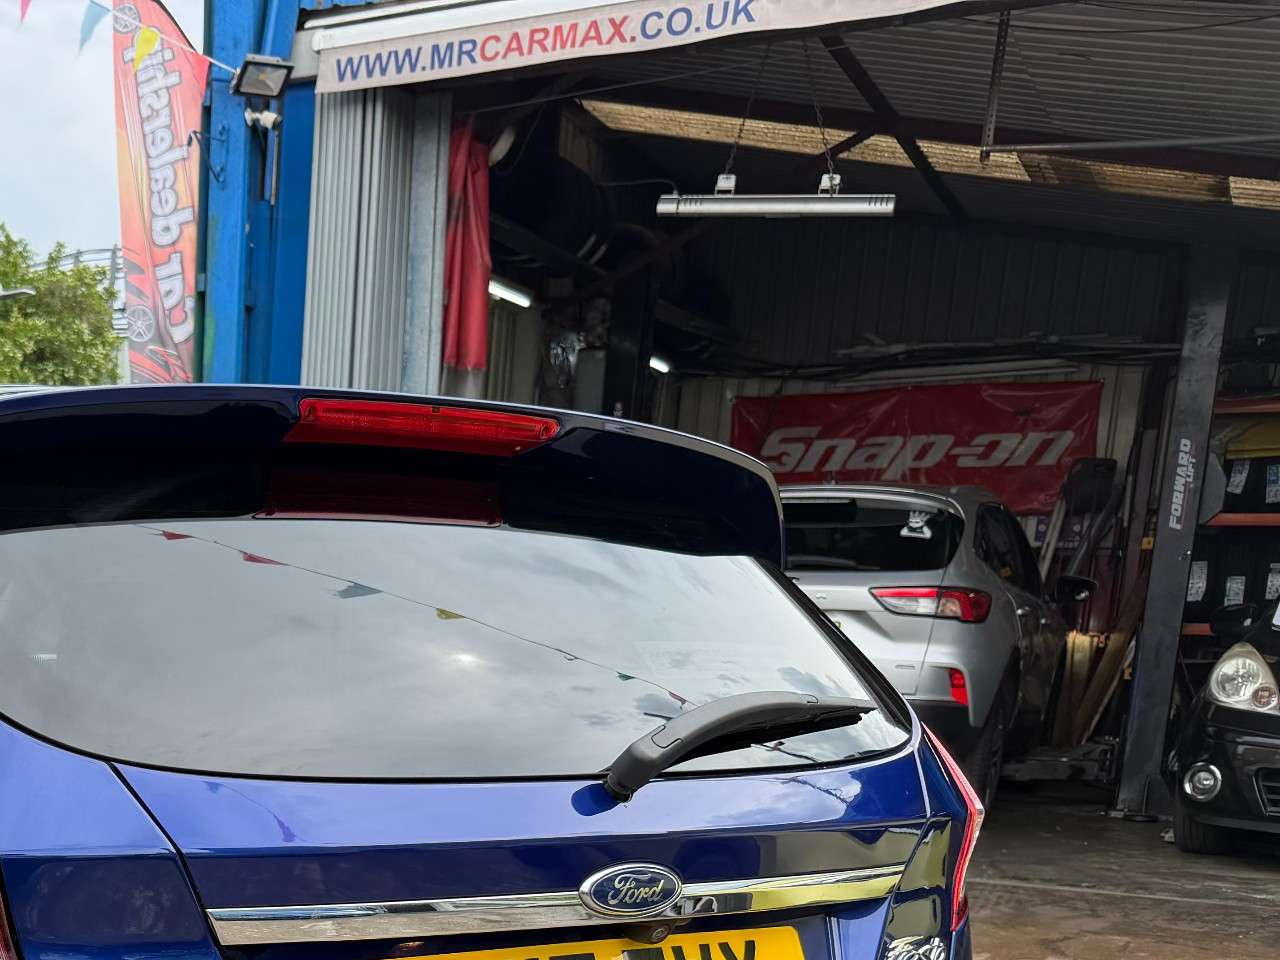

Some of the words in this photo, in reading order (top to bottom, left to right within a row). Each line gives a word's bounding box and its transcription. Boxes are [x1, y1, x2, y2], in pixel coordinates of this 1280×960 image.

[336, 0, 756, 82] WWW.MRCARMAX.CO.UK
[760, 427, 1075, 481] Snap-on
[1169, 438, 1192, 530] FORWARD
[608, 873, 665, 905] Ford
